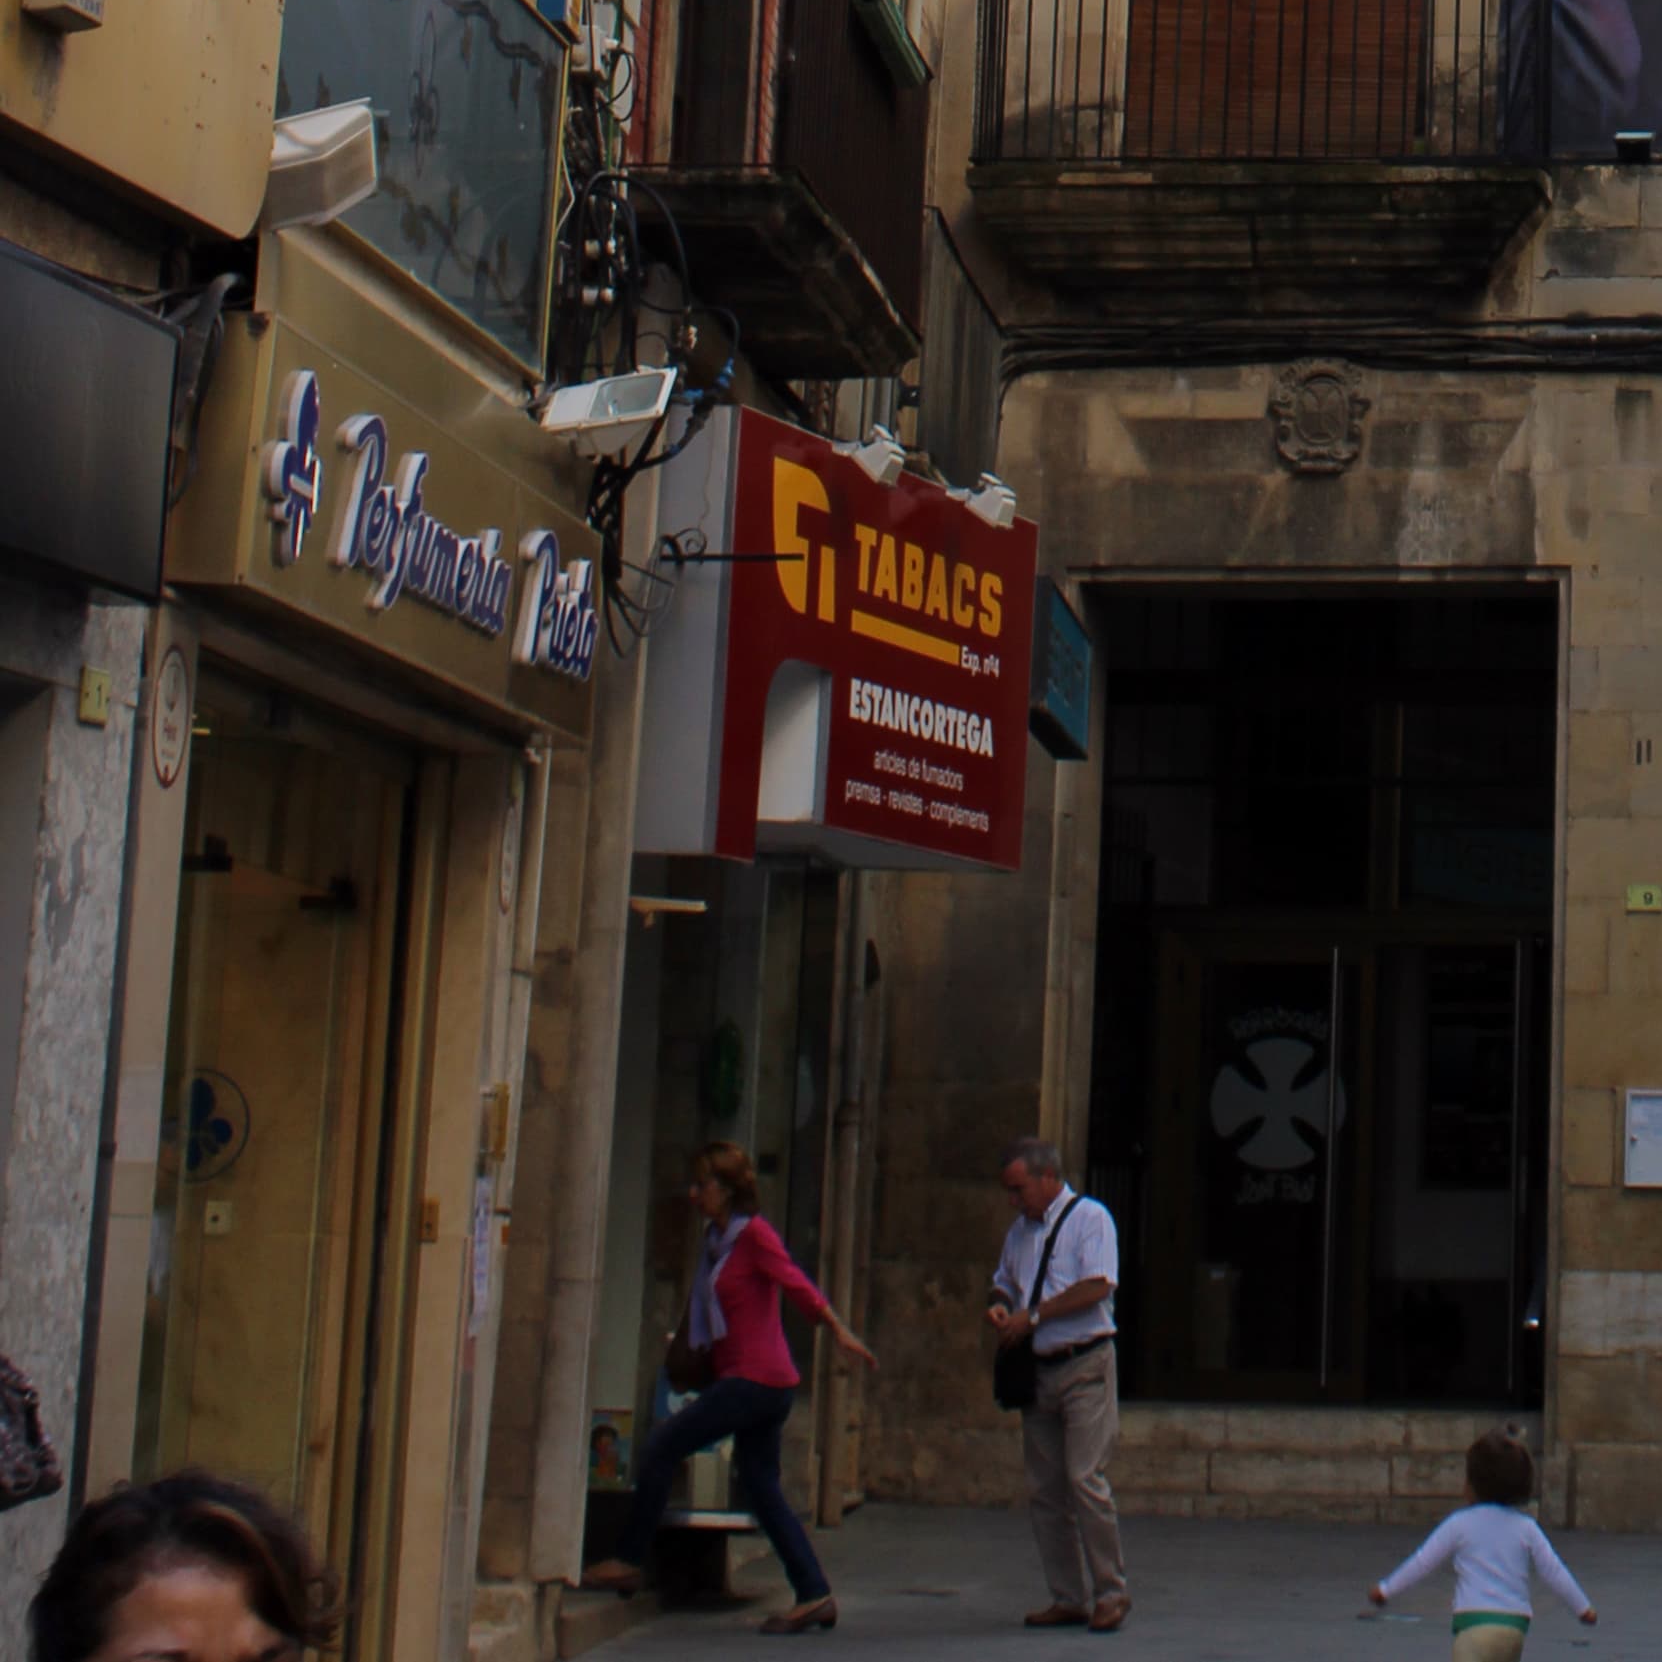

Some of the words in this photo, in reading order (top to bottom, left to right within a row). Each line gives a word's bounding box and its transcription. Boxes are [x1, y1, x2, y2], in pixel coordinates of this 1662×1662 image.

[328, 413, 512, 638] Perfumeria
[854, 522, 1003, 638] TABACS
[960, 645, 981, 677] Exp.
[849, 677, 994, 758] ESTANCORTEGA
[873, 749, 906, 777] articles
[908, 758, 921, 781] de
[922, 758, 964, 793] fumadors
[845, 779, 882, 806] premsa
[888, 789, 923, 816] revistes
[930, 799, 990, 834] complements
[1643, 891, 1654, 905] 9
